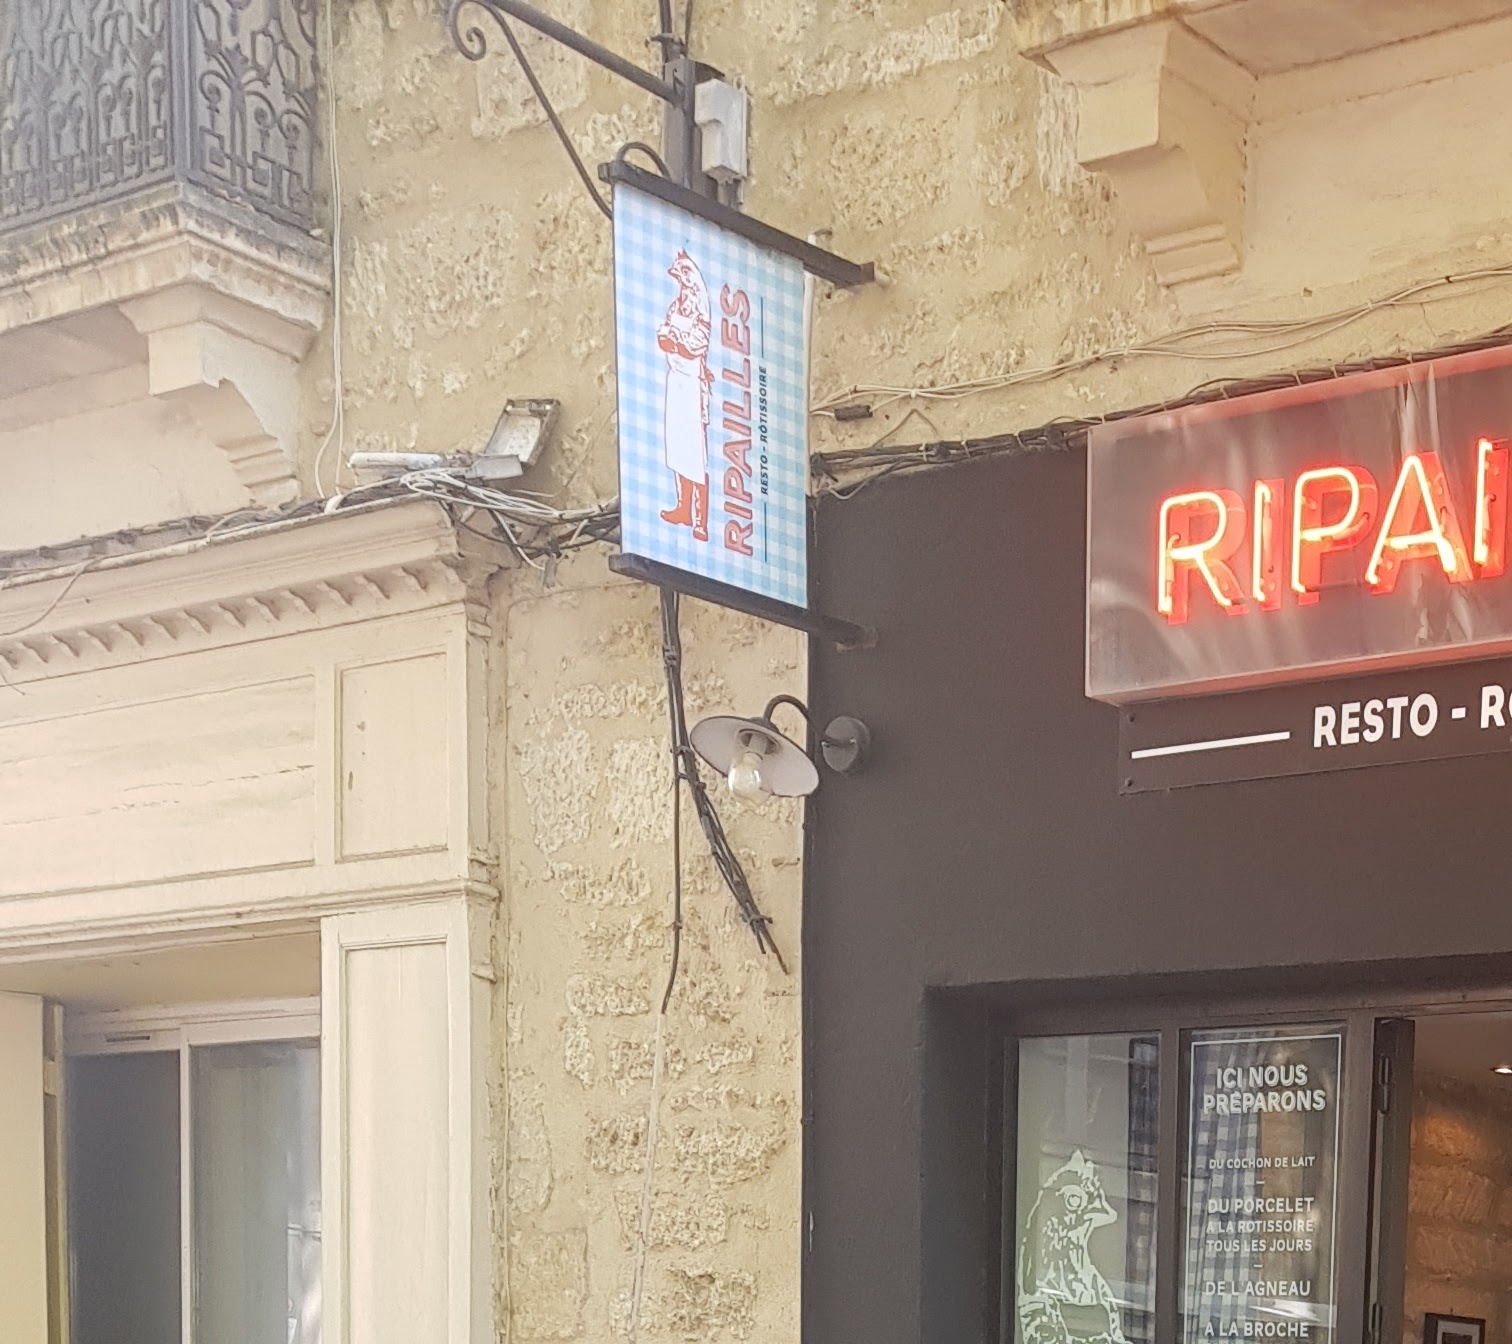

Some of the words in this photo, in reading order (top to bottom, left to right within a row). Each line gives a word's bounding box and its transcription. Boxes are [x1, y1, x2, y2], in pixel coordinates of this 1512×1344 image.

[720, 283, 754, 557] RIPAILLES
[761, 455, 769, 496] RESTO
[1313, 693, 1438, 748] RESTO
[1216, 1067, 1242, 1089] ICI
[1248, 1064, 1308, 1088] NOUS
[1203, 1089, 1326, 1114] PRÉPARONS
[1209, 1159, 1224, 1169] DU
[1226, 1157, 1271, 1168] COCHON
[1274, 1157, 1287, 1167] DE
[1291, 1156, 1315, 1167] LAIT
[1208, 1198, 1229, 1213] DU
[1234, 1197, 1314, 1213] PORCELET
[1218, 1220, 1235, 1233] LA
[1238, 1219, 1314, 1233] ROTISSOIRE
[1206, 1240, 1240, 1251] TOUS
[1244, 1239, 1266, 1251] LES
[1270, 1239, 1312, 1251] JOURS
[1205, 1281, 1226, 1296] DE
[1205, 1322, 1214, 1337] A
[1219, 1322, 1239, 1337] LA
[1244, 1322, 1309, 1337] BROCHE
